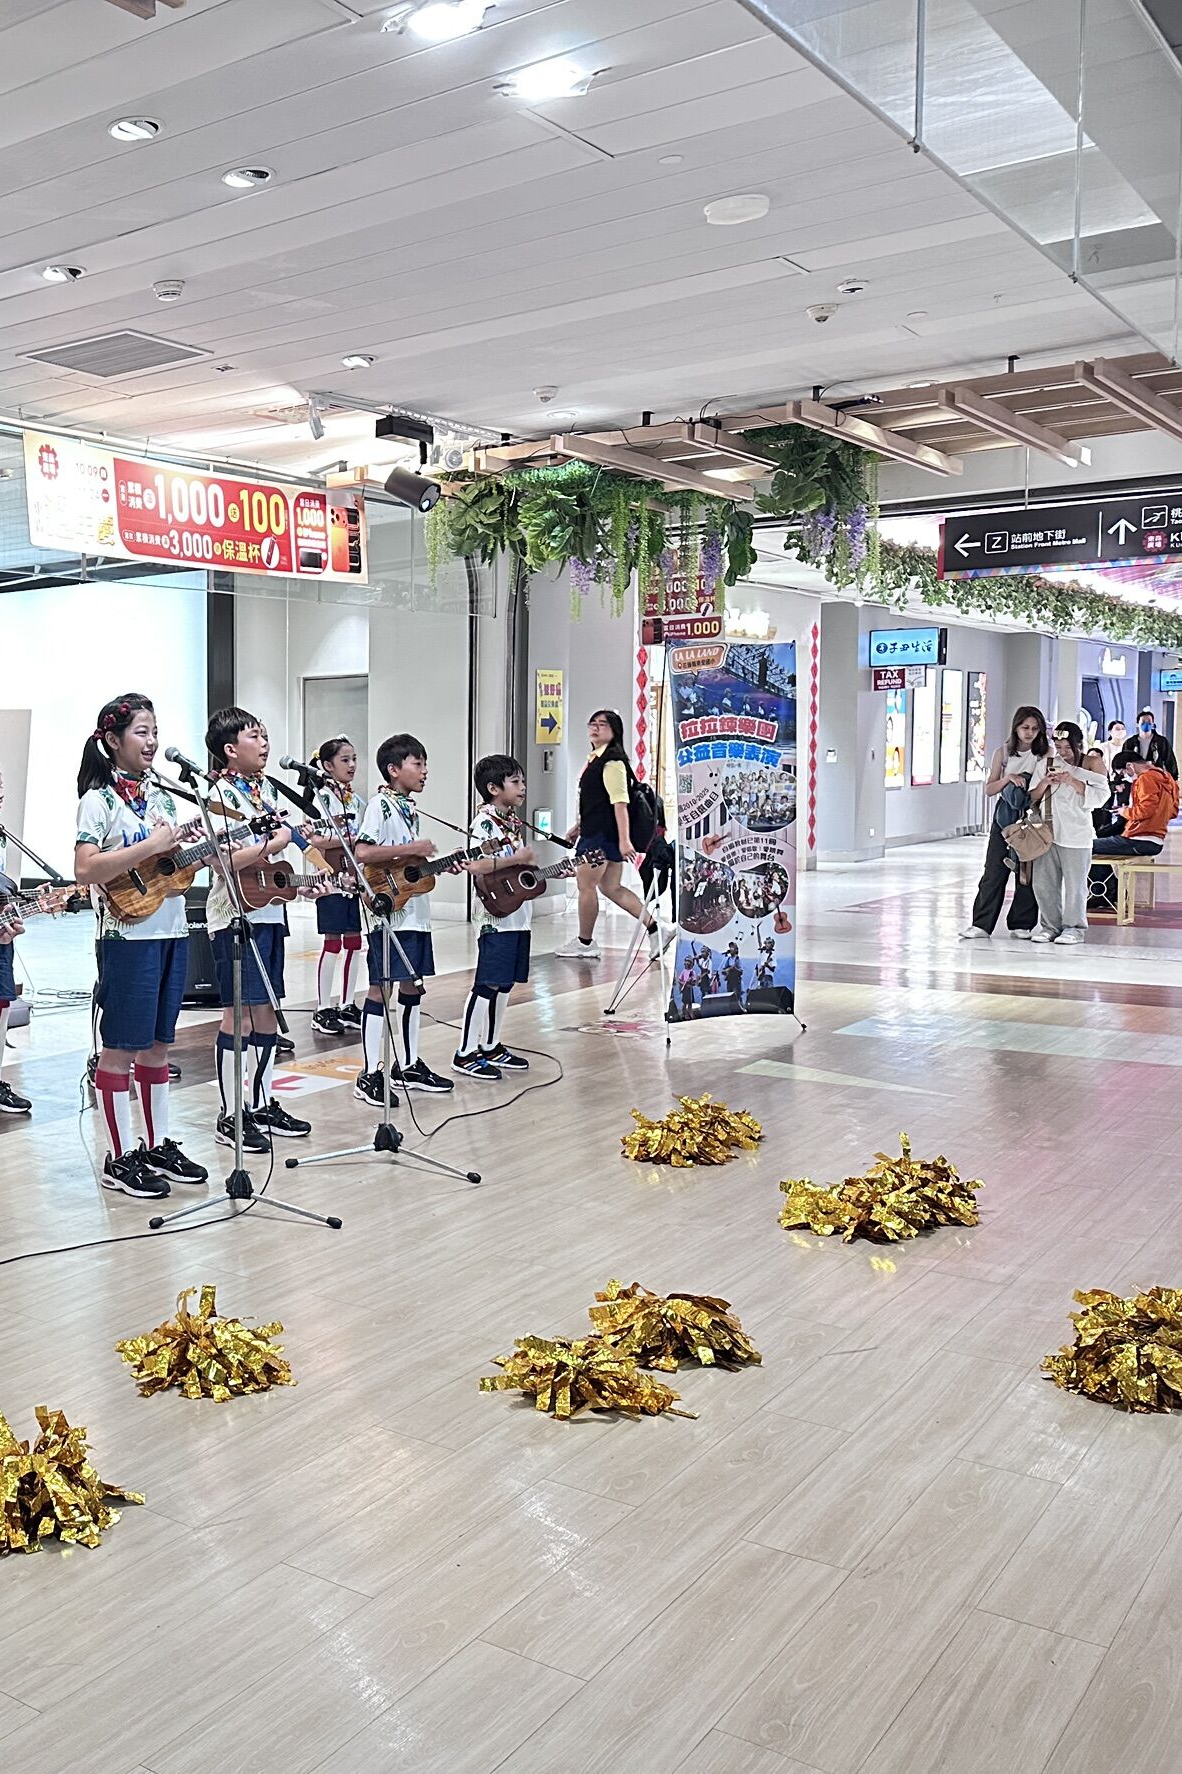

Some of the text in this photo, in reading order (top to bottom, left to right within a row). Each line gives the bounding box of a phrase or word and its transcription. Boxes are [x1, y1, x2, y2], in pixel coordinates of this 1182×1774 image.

[1011, 529, 1066, 544] 站前地下街
[1010, 542, 1033, 550] Station
[675, 648, 720, 662] LA LA LAND
[880, 671, 899, 679] TAX
[677, 740, 783, 768] 公益音樂表演
